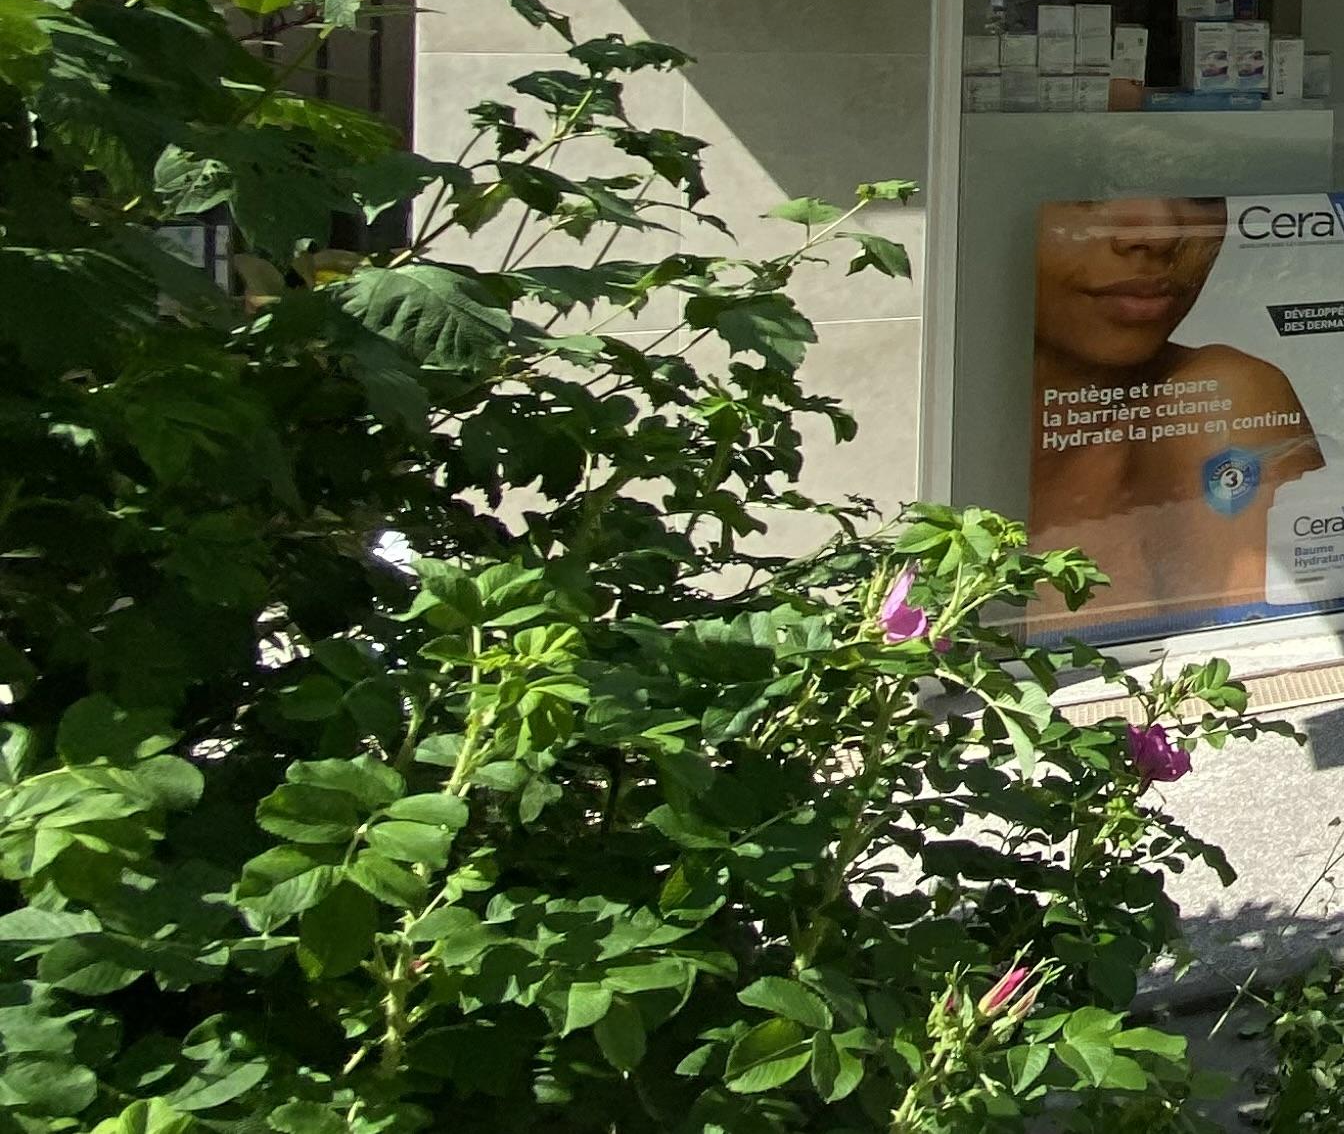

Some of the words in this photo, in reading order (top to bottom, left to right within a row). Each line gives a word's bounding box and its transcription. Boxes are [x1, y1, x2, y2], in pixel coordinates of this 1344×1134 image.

[1284, 304, 1344, 320] DÉVELOPPÉ
[1284, 321, 1305, 332] DES
[1043, 384, 1125, 407] Protège
[1129, 382, 1149, 399] et
[1153, 377, 1218, 399] répare
[1043, 411, 1061, 428] la
[1067, 403, 1151, 426] barrière
[1156, 396, 1232, 418] cutanée
[1042, 426, 1124, 452] Hydrate
[1128, 424, 1147, 441] la
[1151, 419, 1199, 443] peau
[1204, 418, 1227, 434] en
[1232, 410, 1301, 430] continu
